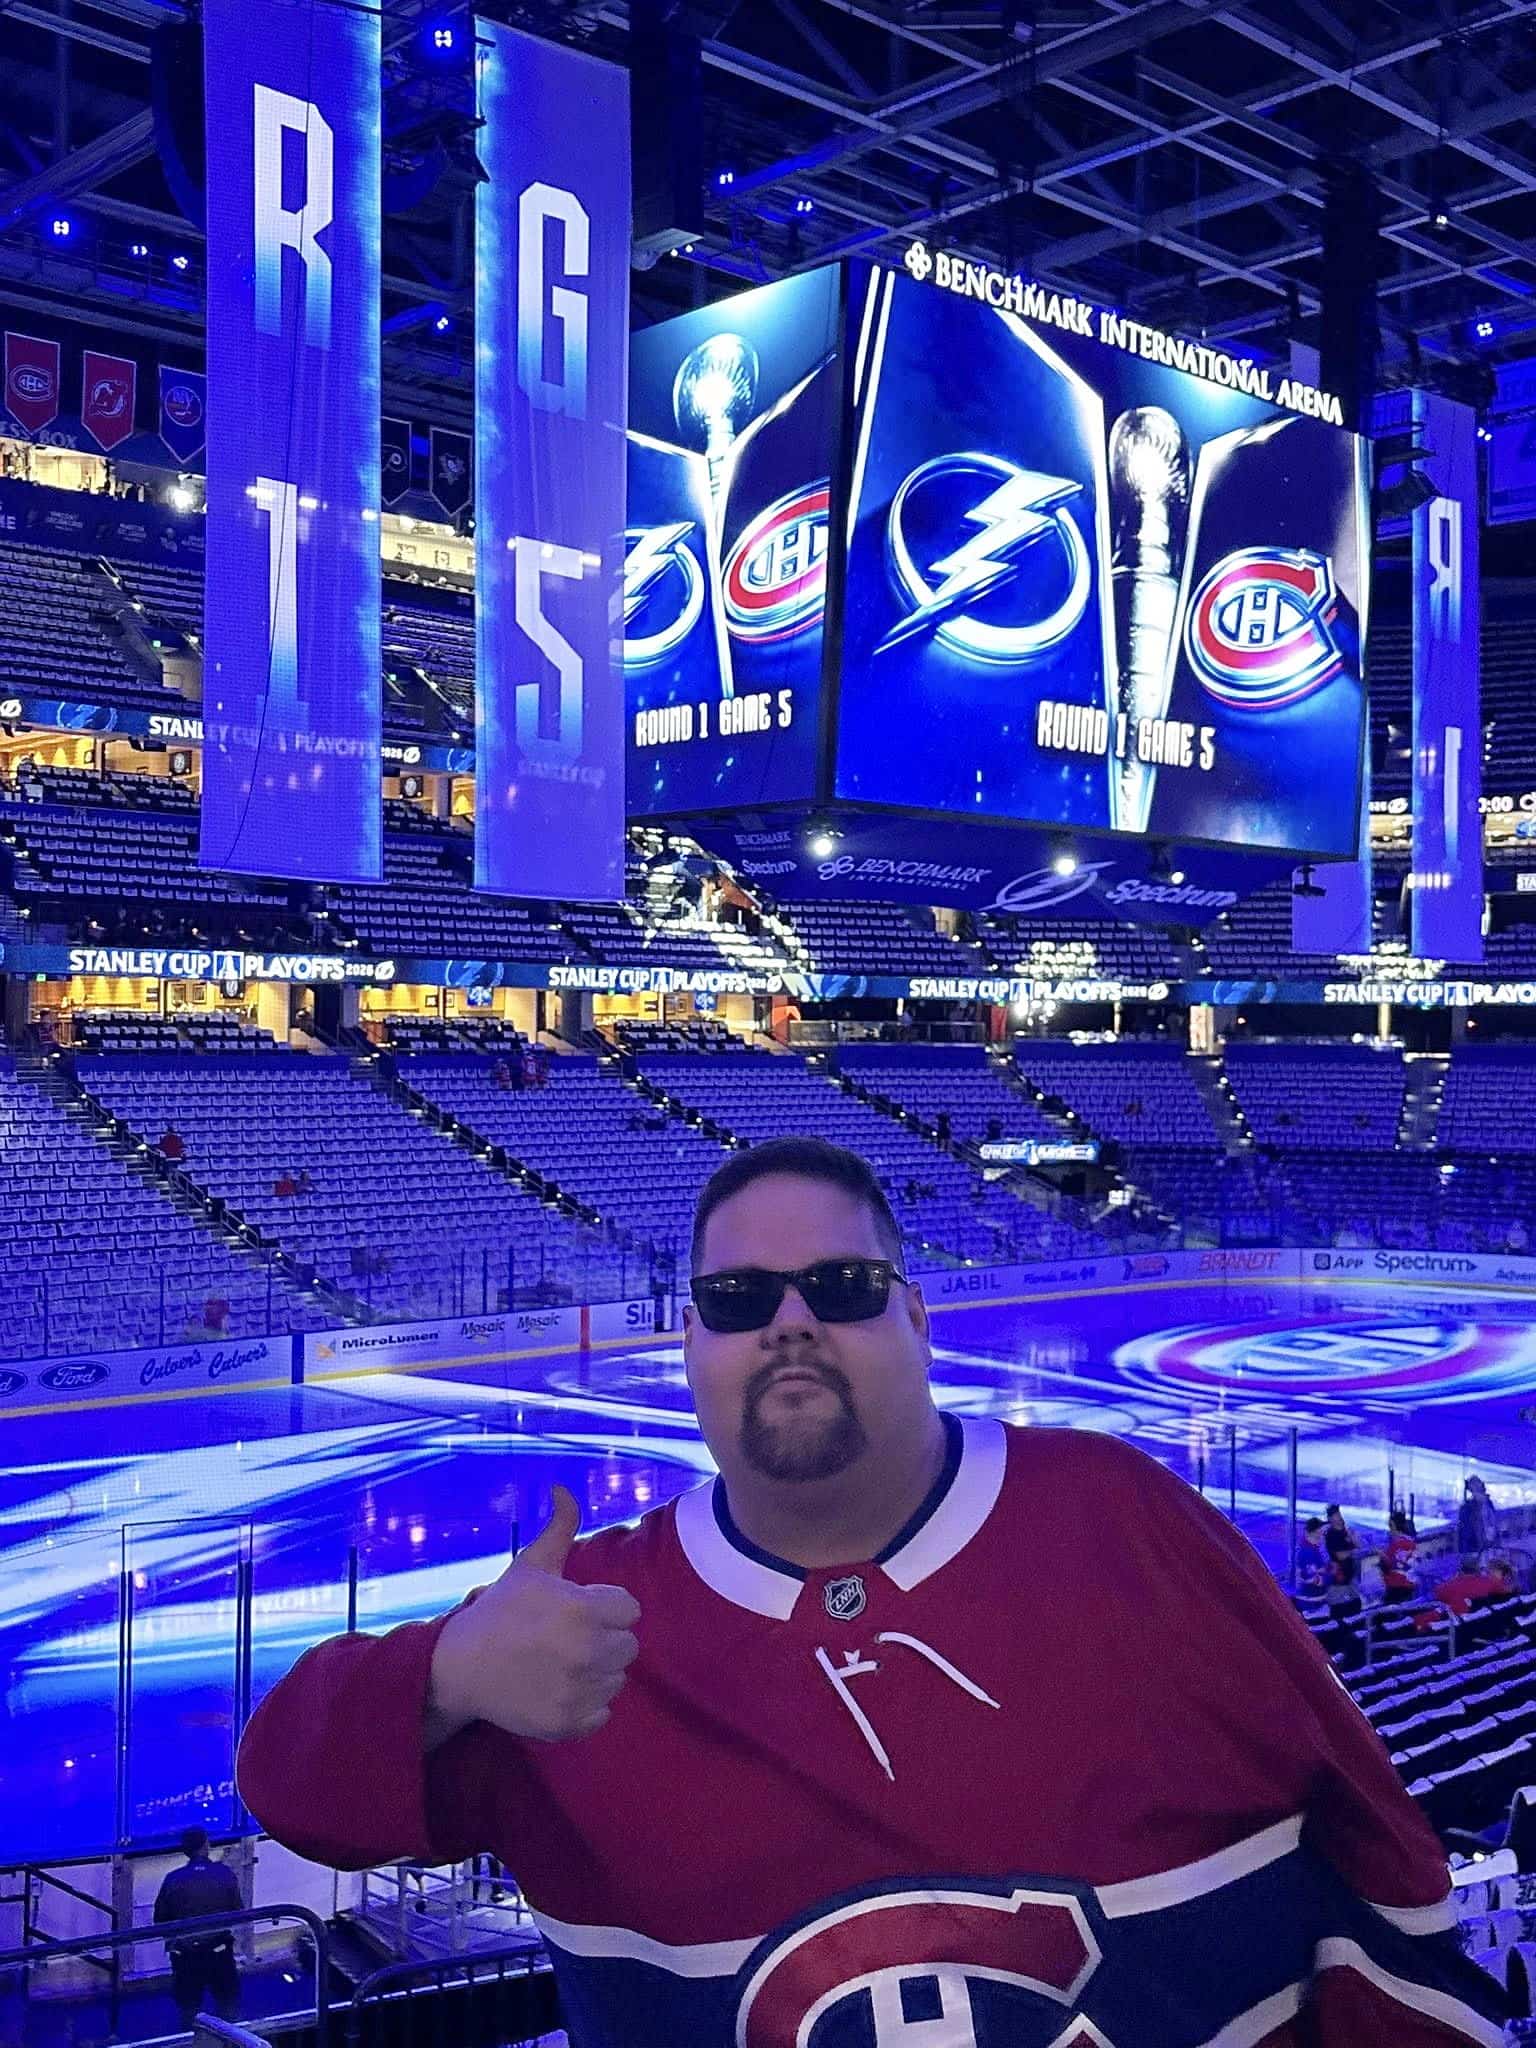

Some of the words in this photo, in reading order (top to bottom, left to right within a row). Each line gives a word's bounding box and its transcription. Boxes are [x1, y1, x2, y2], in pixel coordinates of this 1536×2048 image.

[254, 82, 334, 352] R
[518, 181, 590, 422] G
[935, 252, 1094, 337] BENCHMARK
[1100, 312, 1274, 400] INTERNATIONAL
[1276, 380, 1344, 426] ARENA
[514, 536, 585, 766] 5
[636, 704, 693, 748] ROUND
[699, 702, 708, 739] 1
[719, 693, 772, 736] GAME
[778, 688, 793, 728] 5
[1037, 700, 1109, 756] ROUND
[1115, 712, 1127, 758] 1
[1138, 718, 1195, 768] GAME
[1199, 726, 1216, 771] 5
[742, 858, 797, 877] Spectrum
[855, 858, 993, 883] BENCHMARK
[1105, 879, 1236, 907] Spectrum
[69, 950, 168, 976] STANLEY
[168, 953, 211, 978] CUP
[245, 953, 345, 980] PLAYOFFS
[549, 967, 620, 988] STANLEY
[620, 969, 650, 990] CUP
[673, 970, 747, 992] PLAYOFFS
[909, 978, 978, 998] STANLEY
[979, 979, 1010, 999] CUP
[1035, 980, 1122, 1000] PLAYOFFS
[1324, 984, 1406, 1003] STANLEY
[1406, 984, 1443, 1003] CUP
[1374, 1251, 1477, 1273] Spectrum
[942, 1273, 1002, 1294] JABIL
[460, 1318, 505, 1338] Mosaic
[517, 1312, 561, 1331] Mosaic
[53, 1365, 96, 1387] Ford
